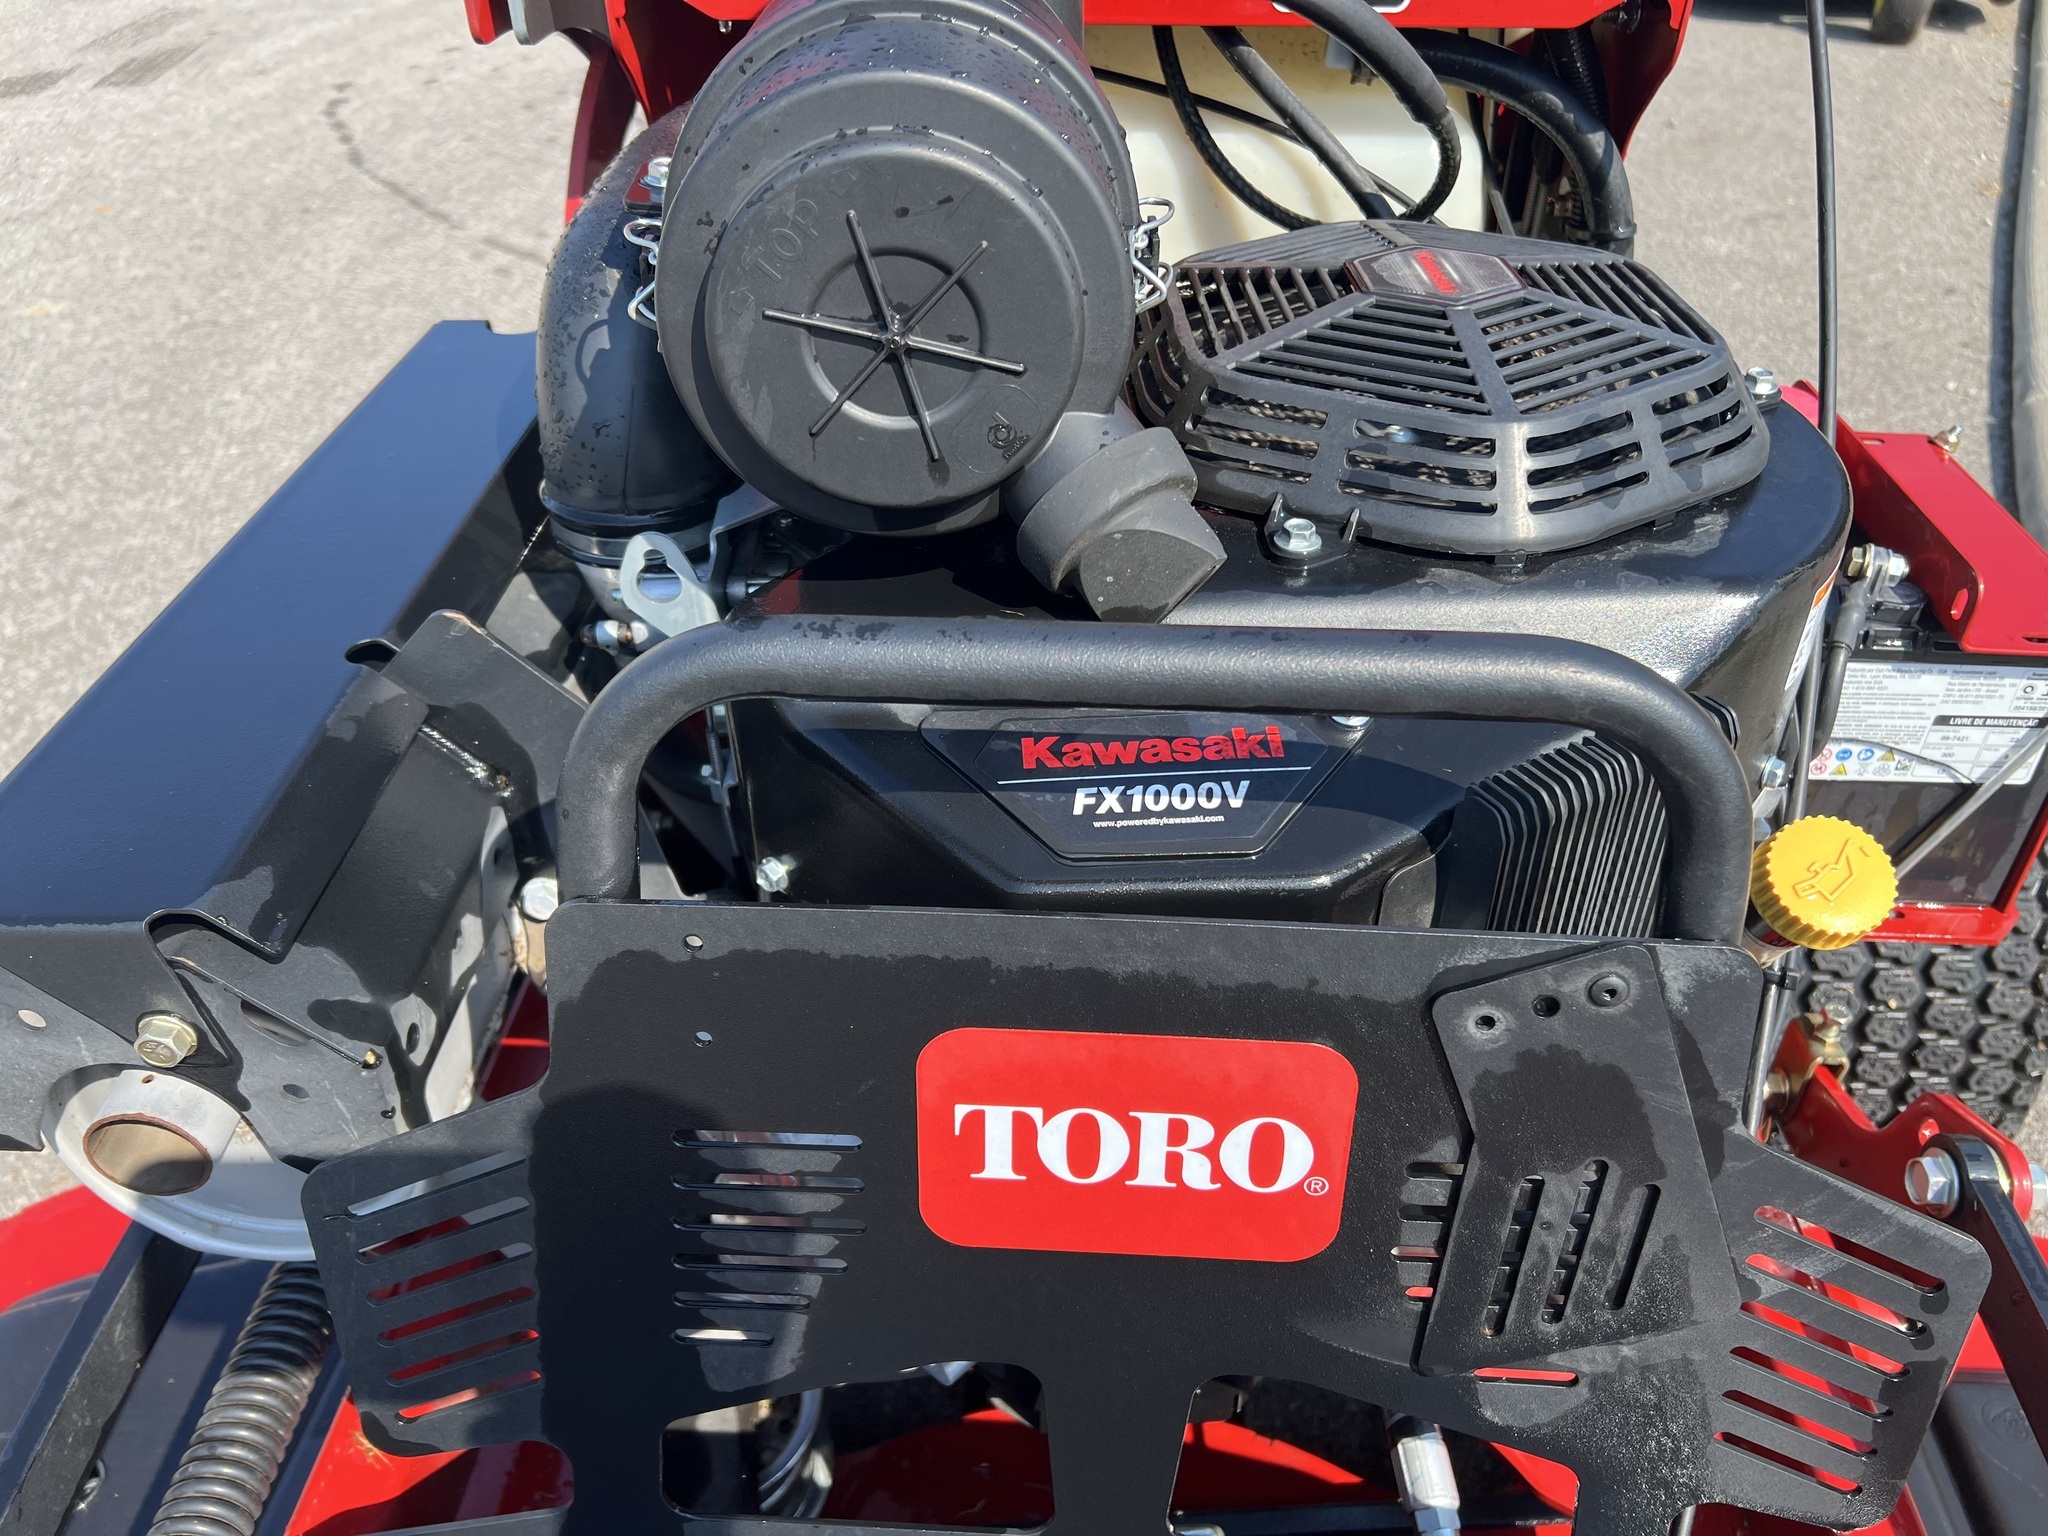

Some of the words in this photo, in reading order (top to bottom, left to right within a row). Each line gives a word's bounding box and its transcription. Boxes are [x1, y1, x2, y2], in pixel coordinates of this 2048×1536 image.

[741, 199, 819, 283] TOP
[1950, 717, 1972, 725] LIVRE
[1974, 717, 1984, 725] DE
[1020, 726, 1285, 769] Kawasaki
[1072, 780, 1250, 816] FX1000V
[1093, 814, 1224, 828] www.poweredbykawasaki.com
[954, 1104, 1315, 1193] TORO
